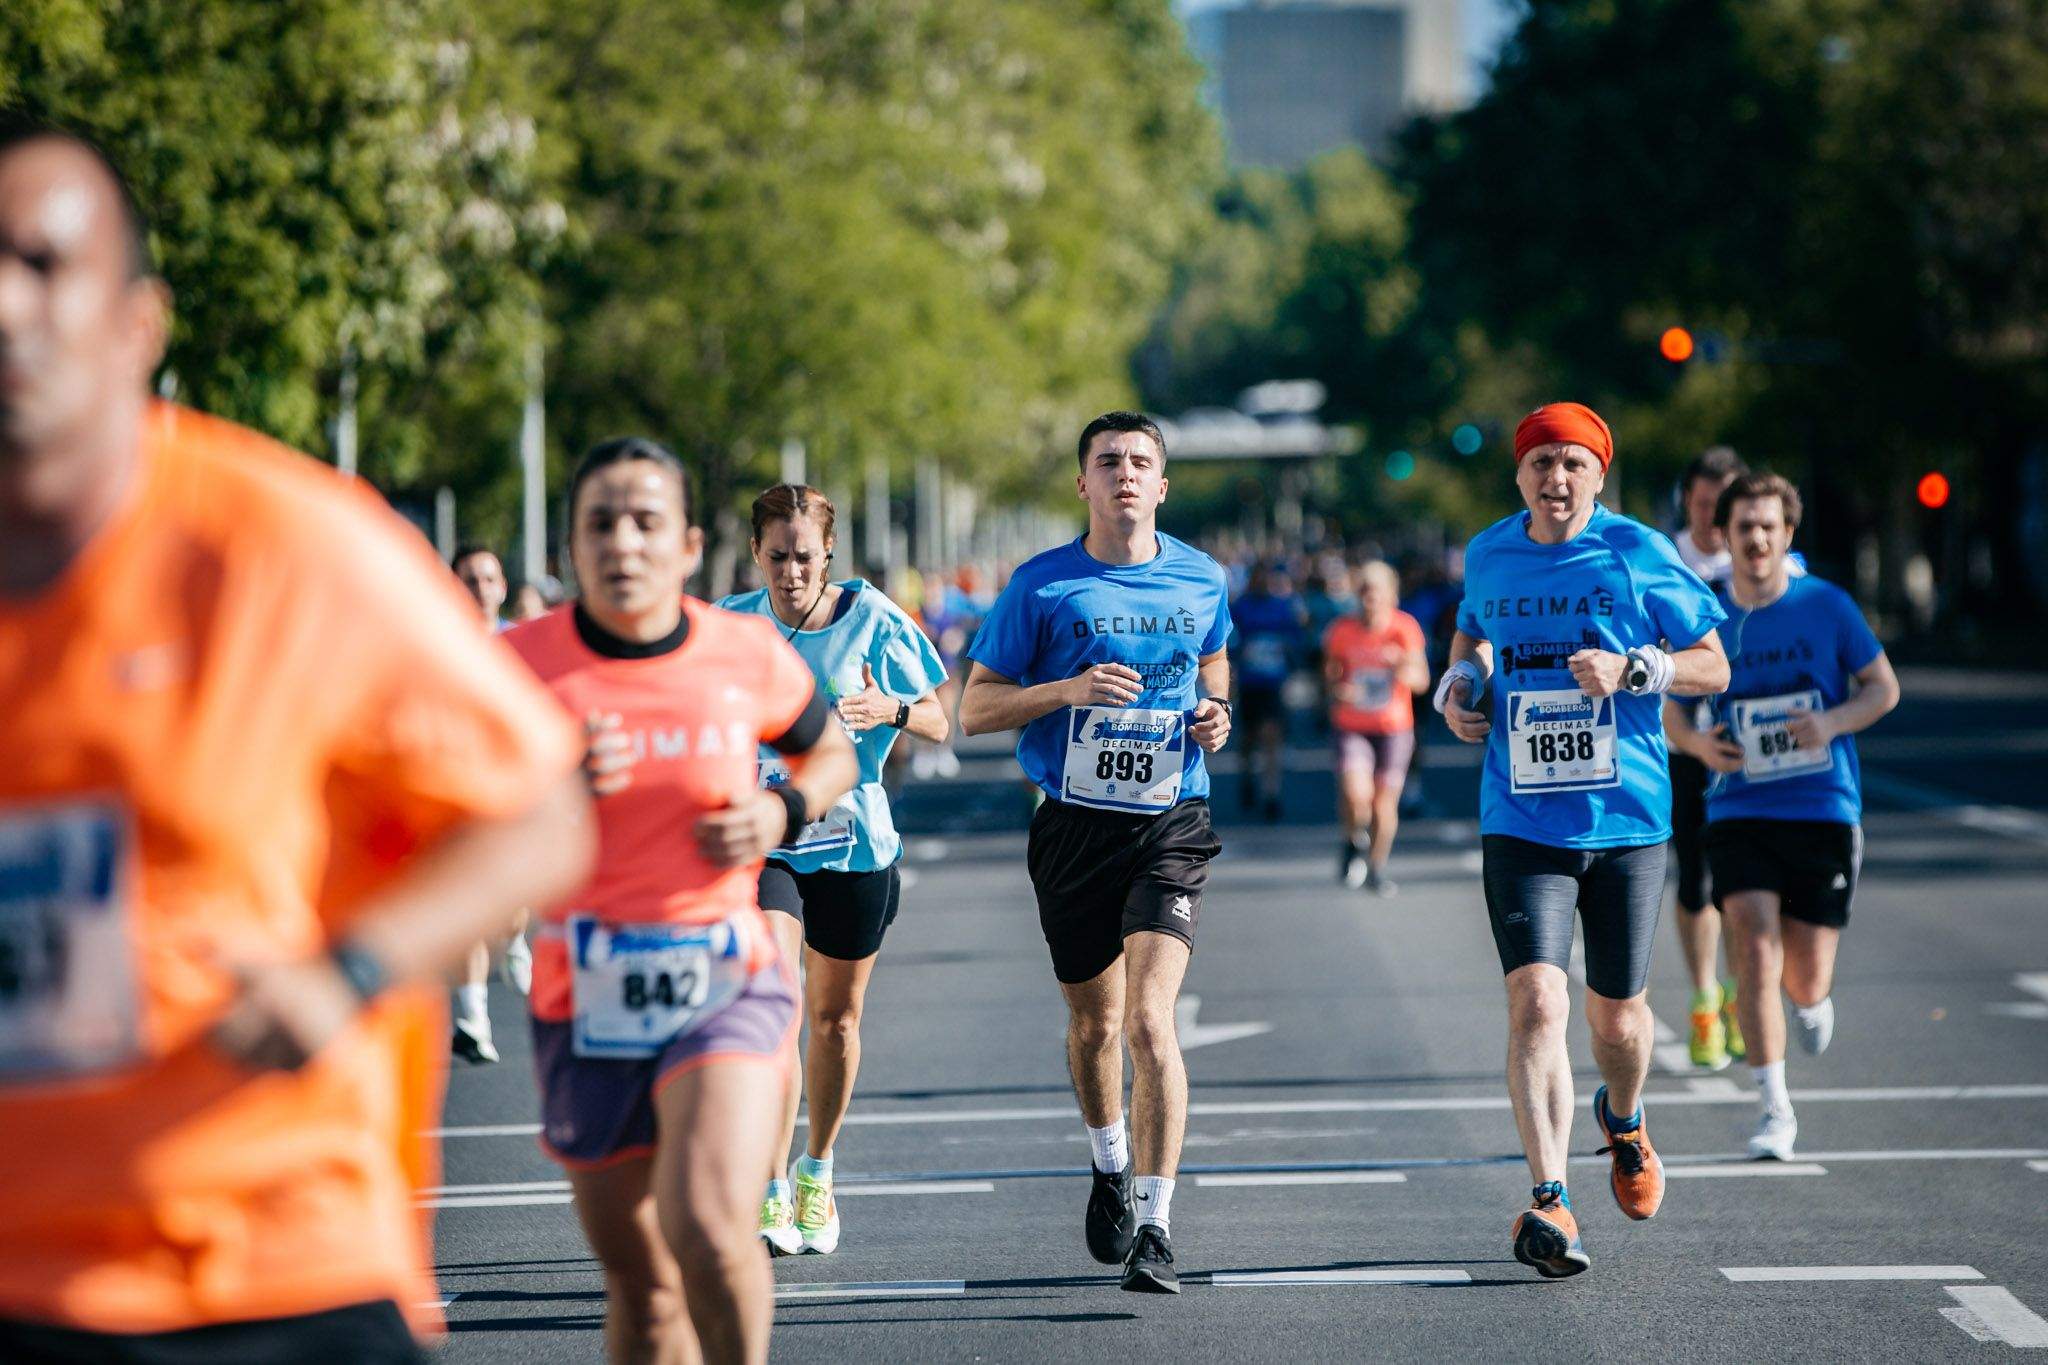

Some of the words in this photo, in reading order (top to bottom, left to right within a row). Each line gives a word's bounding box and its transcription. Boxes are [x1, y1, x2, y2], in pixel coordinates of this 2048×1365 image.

[1484, 596, 1615, 619] DECIMAS
[1073, 616, 1196, 639] DECIMAS
[1127, 664, 1184, 676] MBEROS
[1539, 703, 1592, 714] BOMBEROS
[1111, 722, 1164, 734] BOMBEROS
[1534, 720, 1592, 731] DECIMAS
[632, 722, 749, 759] IMAS
[1102, 739, 1161, 751] DECIMAS
[1527, 731, 1594, 763] 1838
[1760, 731, 1799, 756] 89
[1096, 750, 1154, 784] 893
[624, 969, 697, 1009] 842
